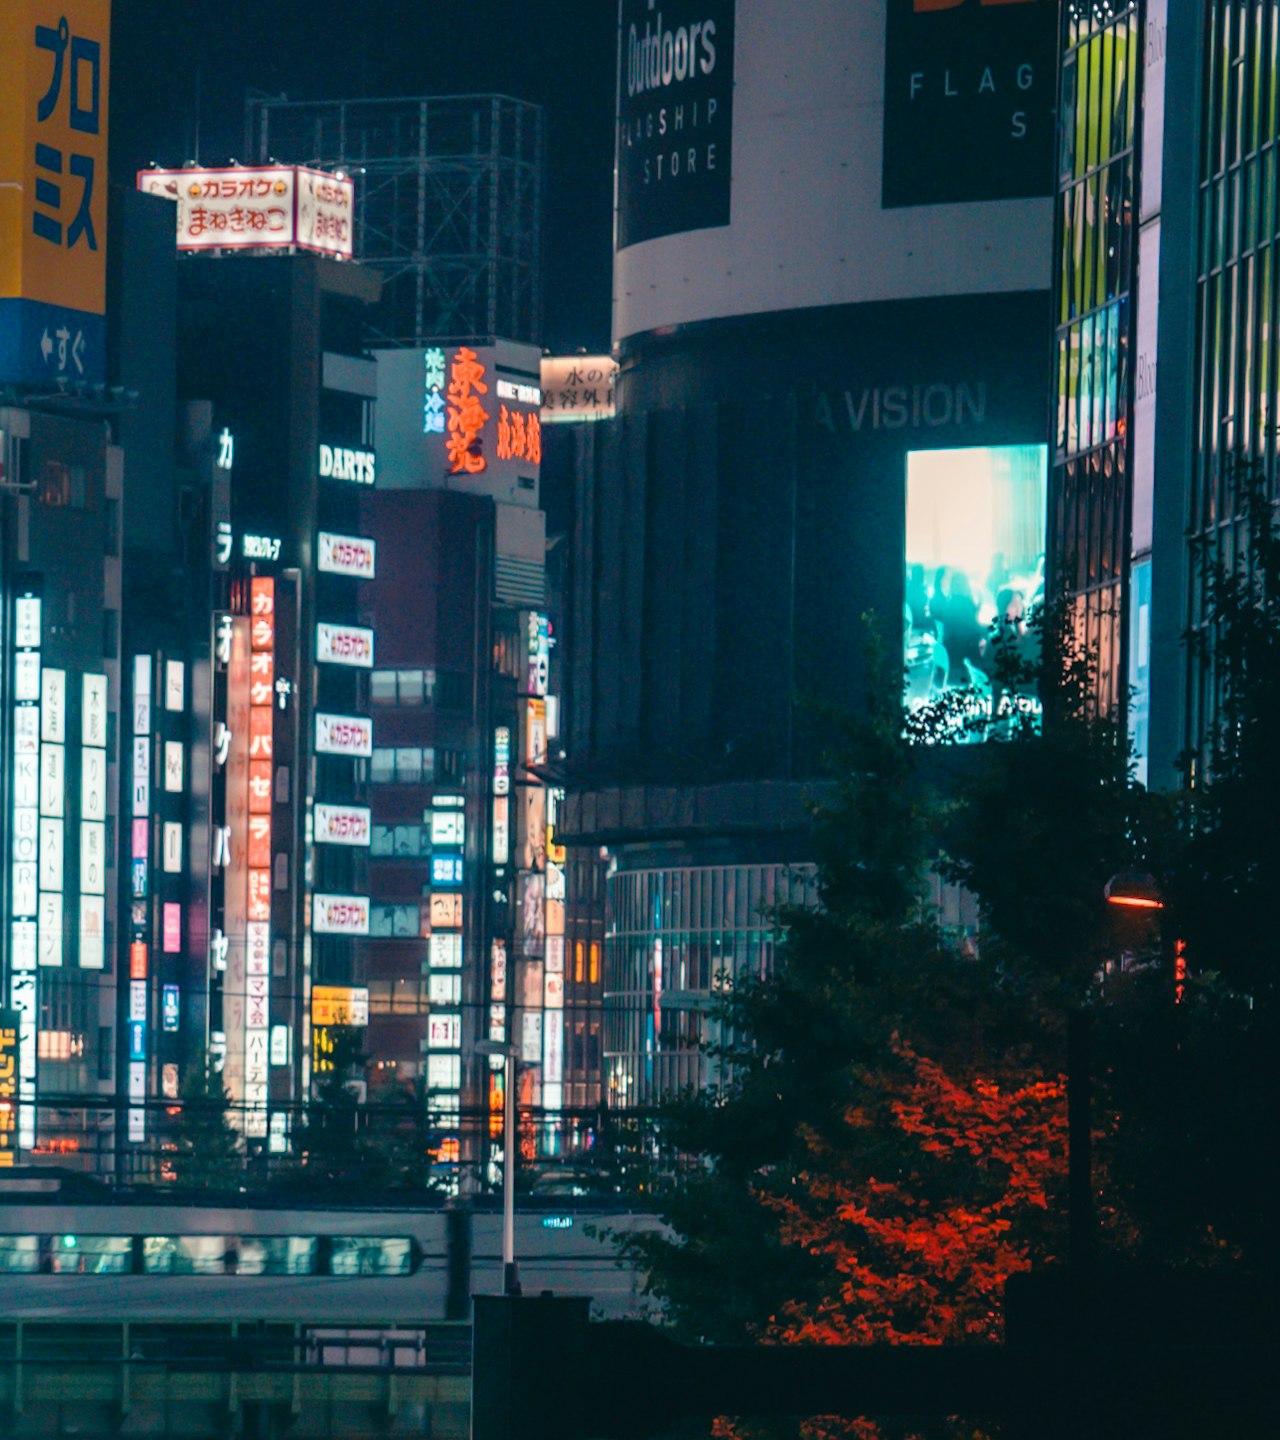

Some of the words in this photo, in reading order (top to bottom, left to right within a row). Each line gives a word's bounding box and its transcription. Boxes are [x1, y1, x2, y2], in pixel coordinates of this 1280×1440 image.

[627, 15, 717, 98] Outdoors
[32, 16, 102, 252] プロミス
[620, 97, 719, 148] FLAGSHIP
[643, 141, 718, 186] STORE
[202, 179, 272, 199] カラオケ
[188, 206, 287, 236] まねきねこ
[54, 327, 87, 373] すぐ
[446, 346, 490, 475] 東海苑
[844, 382, 987, 432] VISION
[319, 444, 375, 485] DARTS
